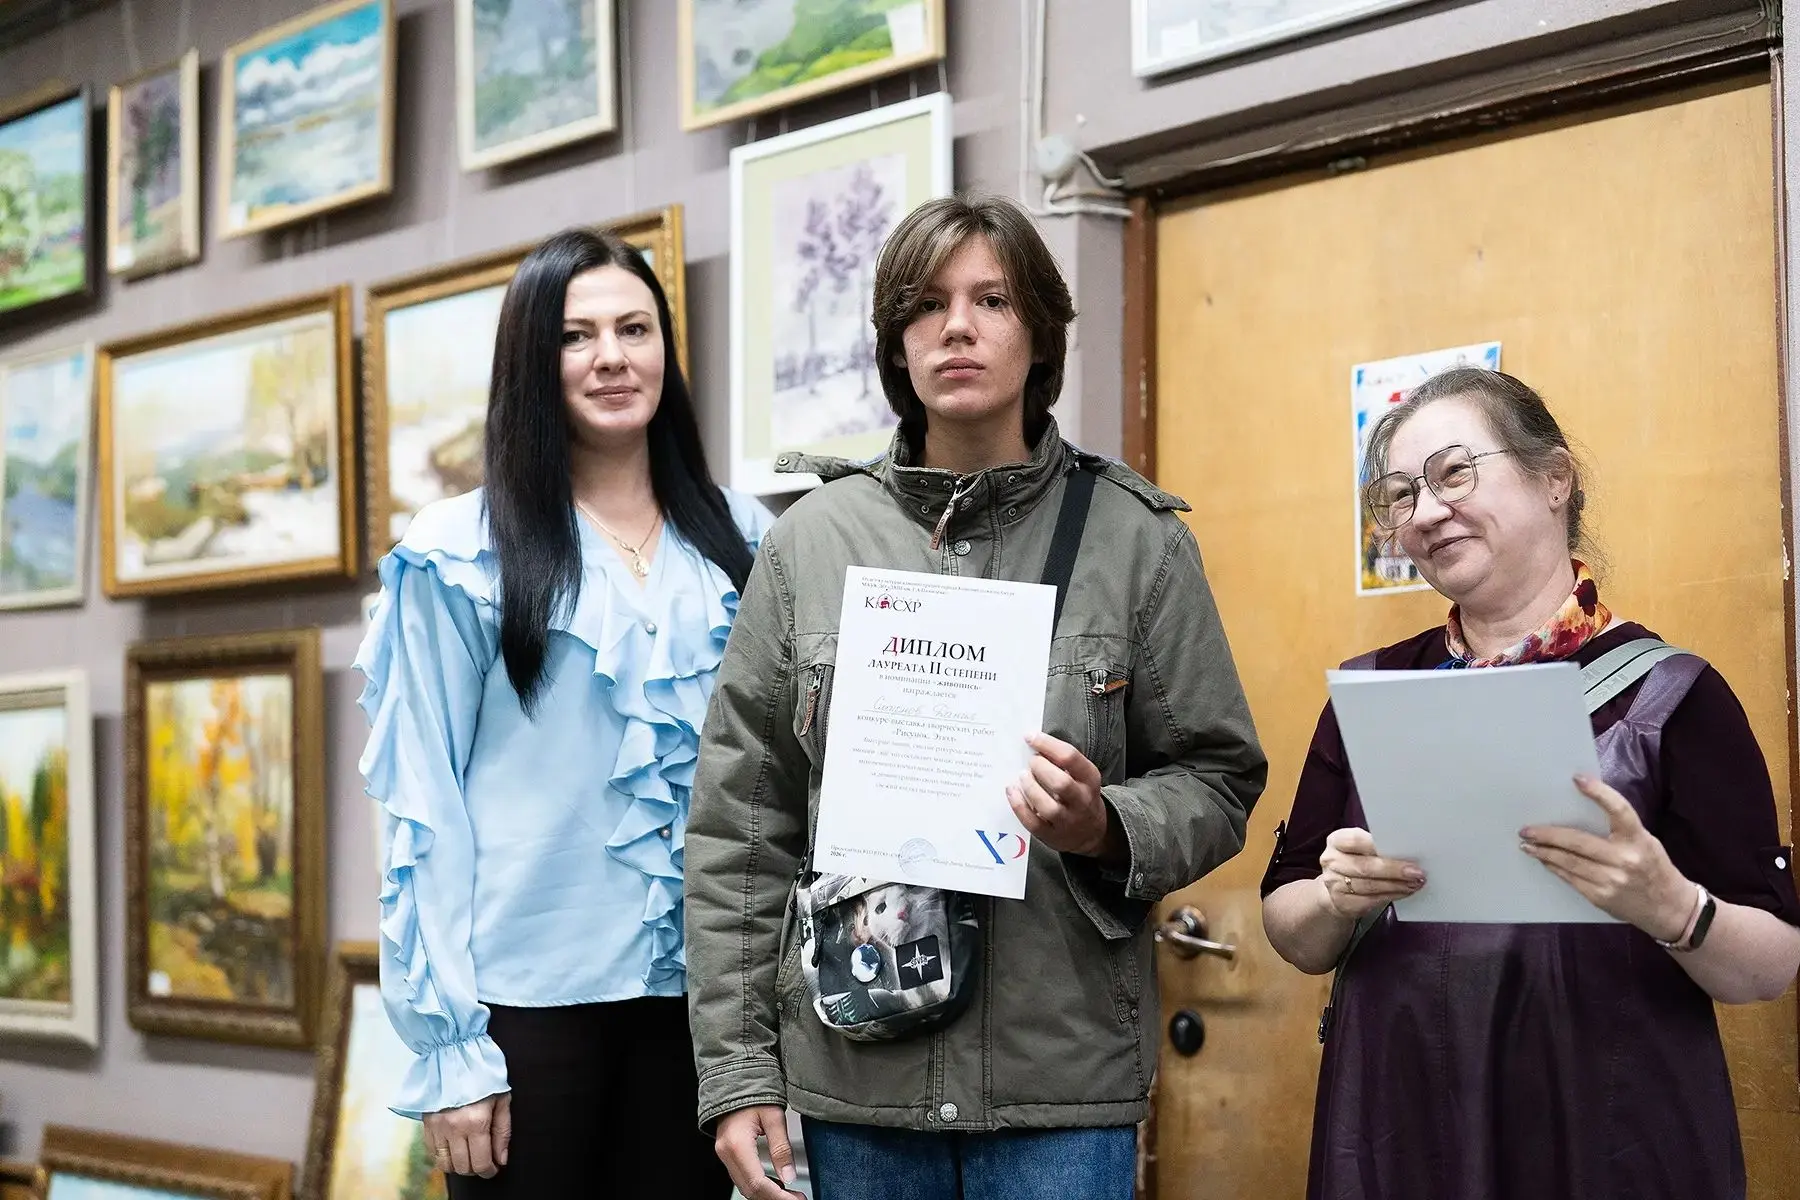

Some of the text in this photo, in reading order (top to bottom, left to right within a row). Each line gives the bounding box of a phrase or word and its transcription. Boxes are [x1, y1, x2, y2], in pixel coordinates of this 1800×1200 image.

[882, 636, 986, 662] ДИПЛОМ
[868, 659, 997, 681] ЛАУРЕАТА II СТЕПЕНИ
